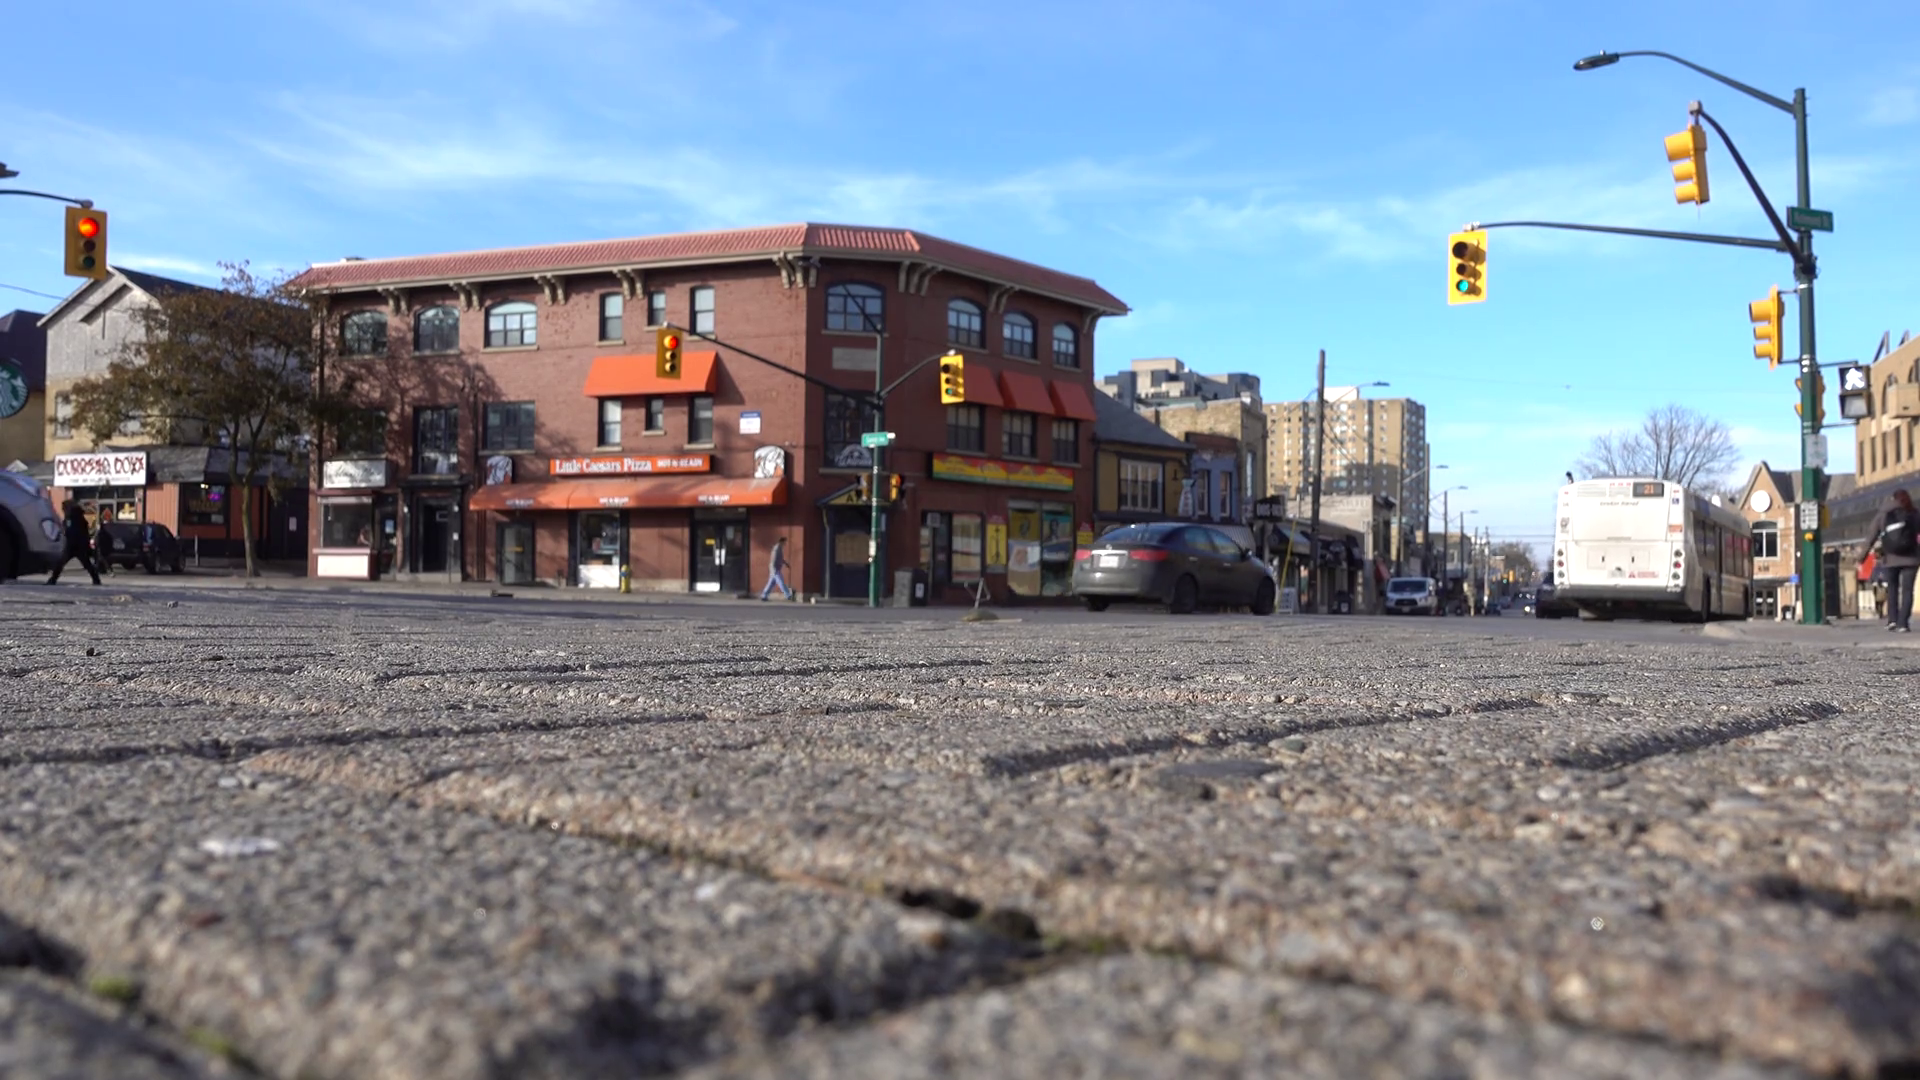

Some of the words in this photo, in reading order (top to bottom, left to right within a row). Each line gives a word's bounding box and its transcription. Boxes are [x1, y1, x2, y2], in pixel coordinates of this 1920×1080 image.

[555, 458, 581, 473] Little
[582, 458, 621, 473] Caesars
[623, 457, 652, 473] Pizza
[1644, 484, 1654, 495] 21
